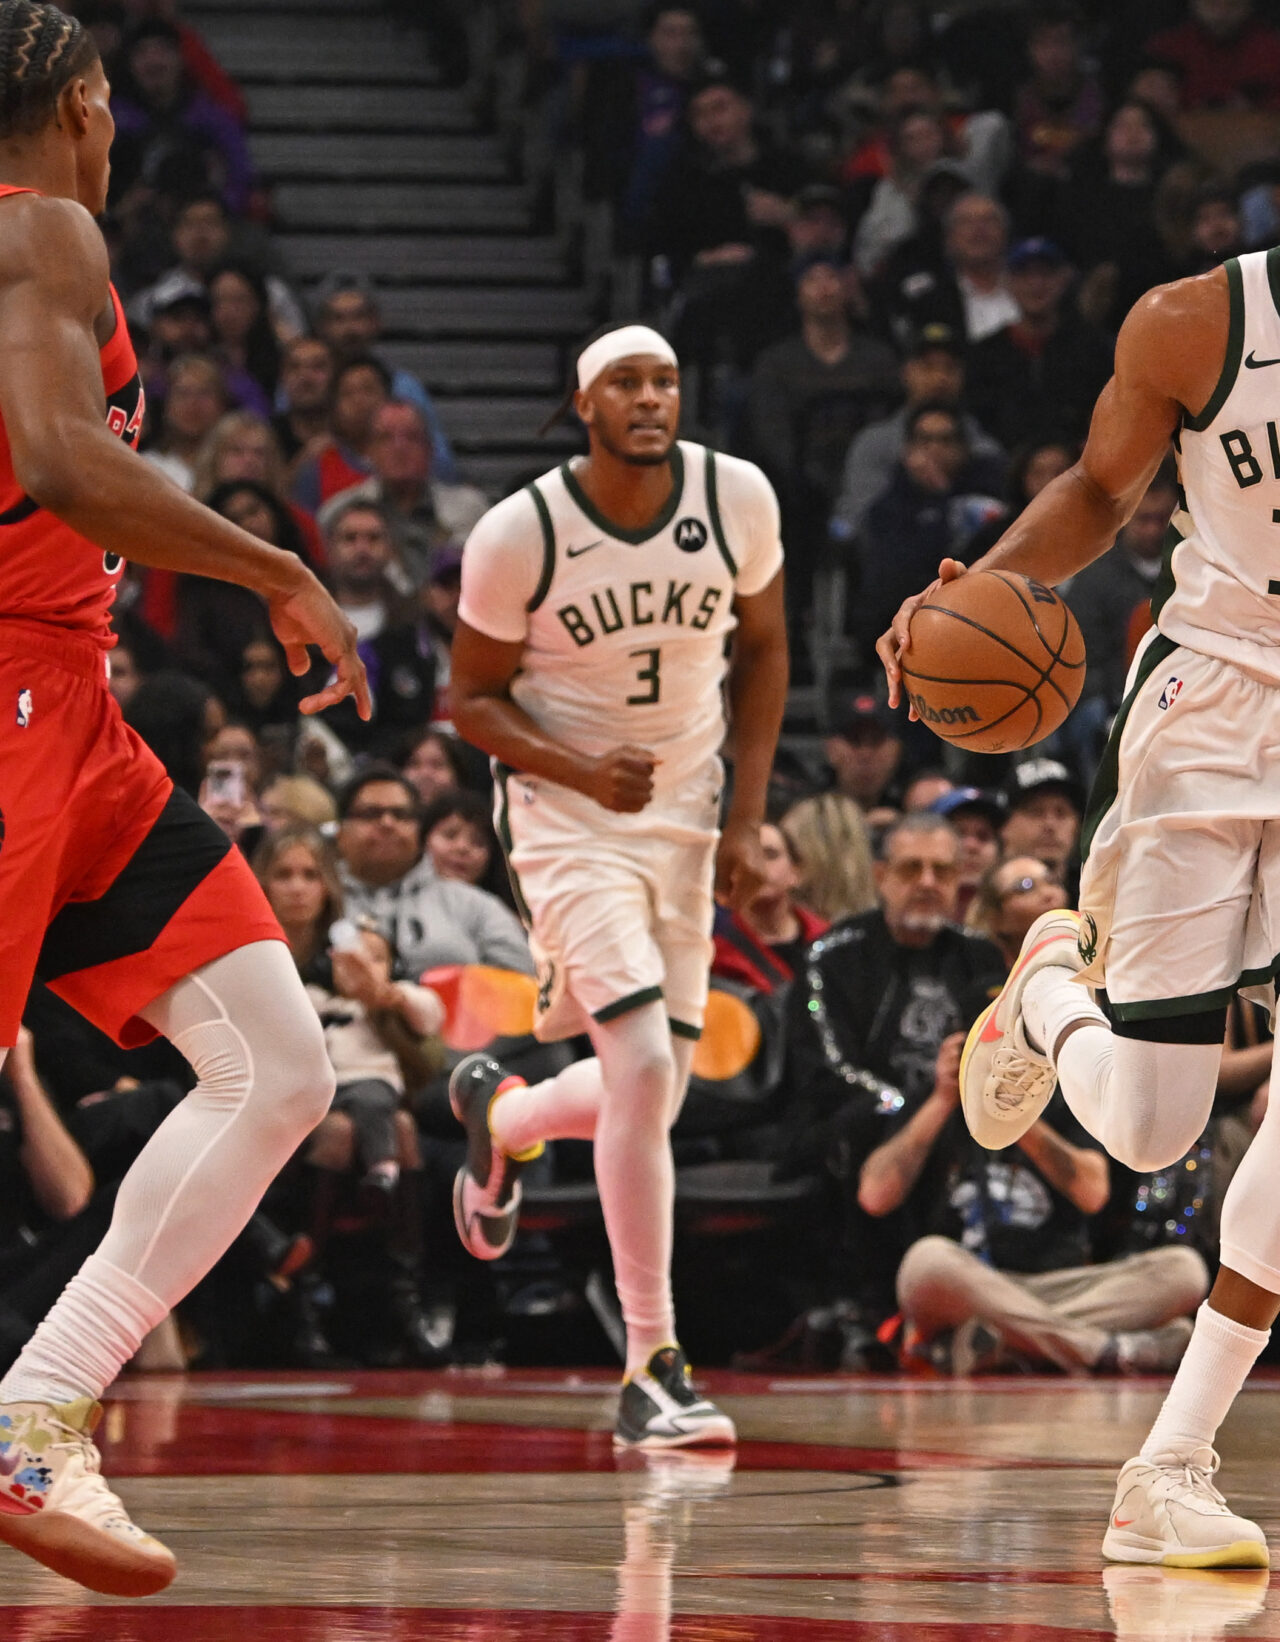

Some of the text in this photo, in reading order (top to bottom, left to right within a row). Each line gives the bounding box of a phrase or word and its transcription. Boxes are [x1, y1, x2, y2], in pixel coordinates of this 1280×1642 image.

[557, 579, 723, 648] BUCKS
[626, 648, 661, 706] 3
[908, 691, 982, 725] ilson
